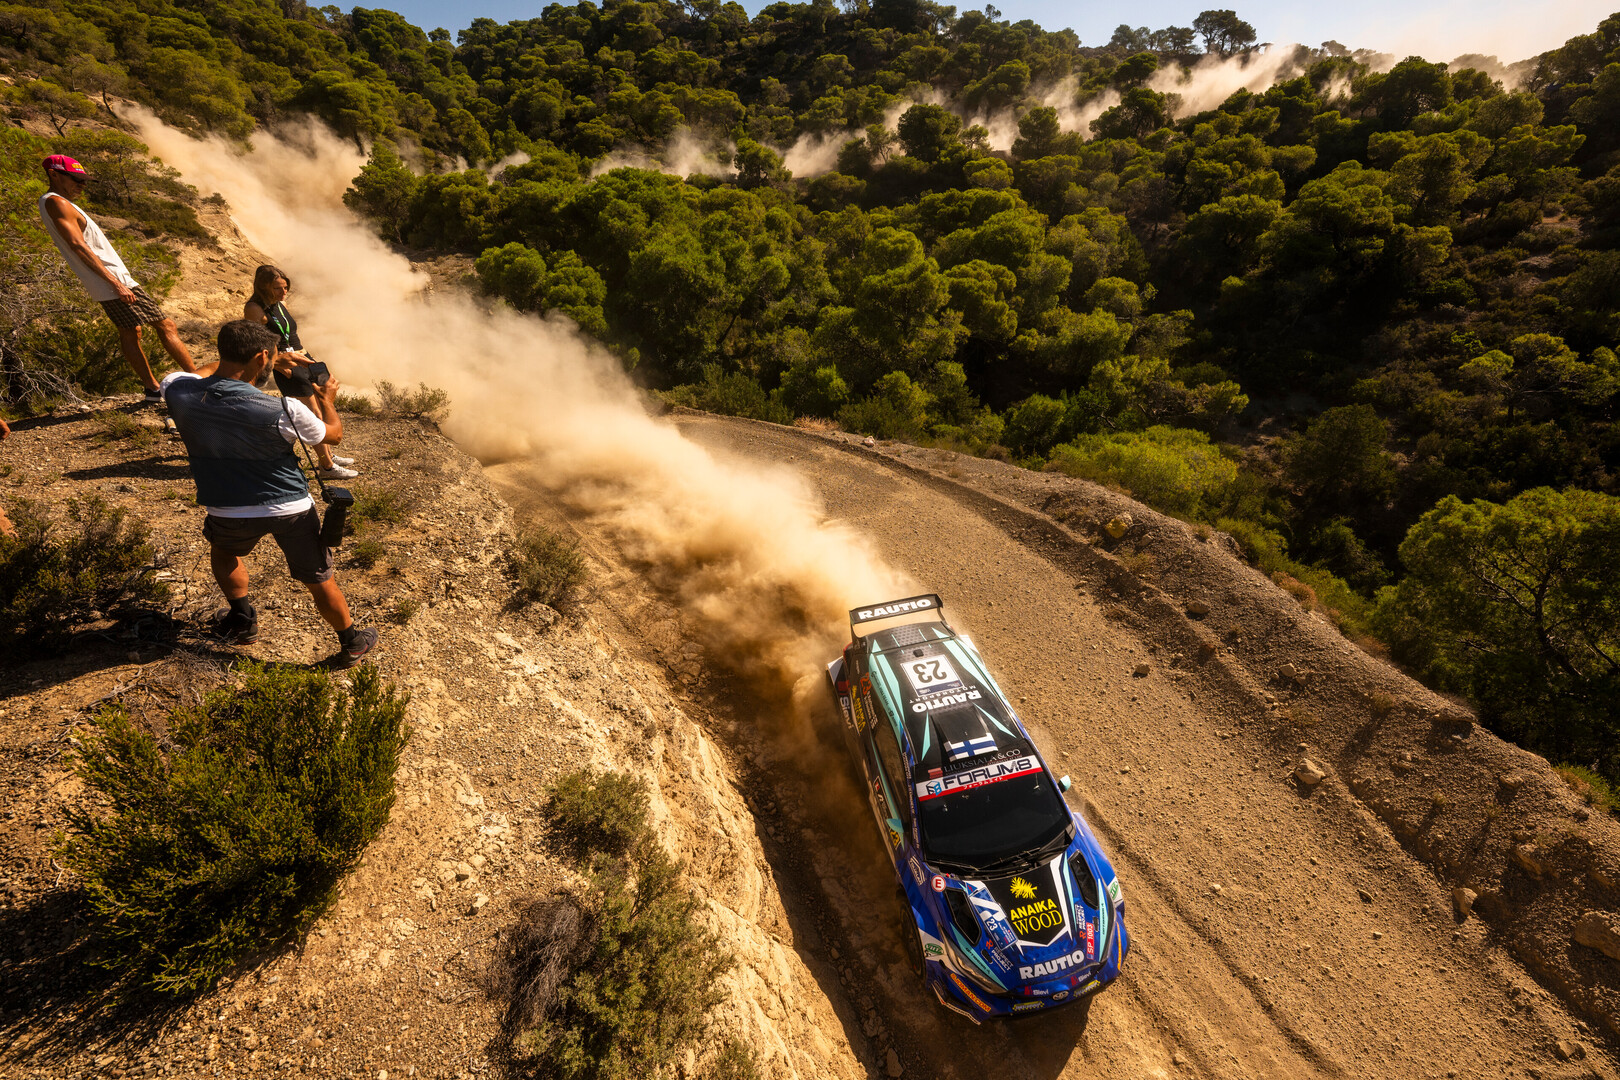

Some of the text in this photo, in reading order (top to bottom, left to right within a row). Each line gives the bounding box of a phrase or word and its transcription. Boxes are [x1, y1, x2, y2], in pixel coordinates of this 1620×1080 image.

[858, 599, 932, 620] RAUTIO
[860, 672, 872, 695] 23
[912, 660, 947, 684] 23
[909, 685, 976, 704] MOTORSPORT
[912, 690, 982, 713] RAUTIO
[840, 696, 854, 729] Sievi
[943, 758, 1032, 789] FORUM8
[935, 879, 942, 888] E
[1010, 898, 1057, 921] ANAIKA
[986, 918, 998, 931] 23
[1013, 909, 1062, 935] WOOD
[991, 949, 1011, 971] PROJECT
[1019, 950, 1085, 980] RAUTIO
